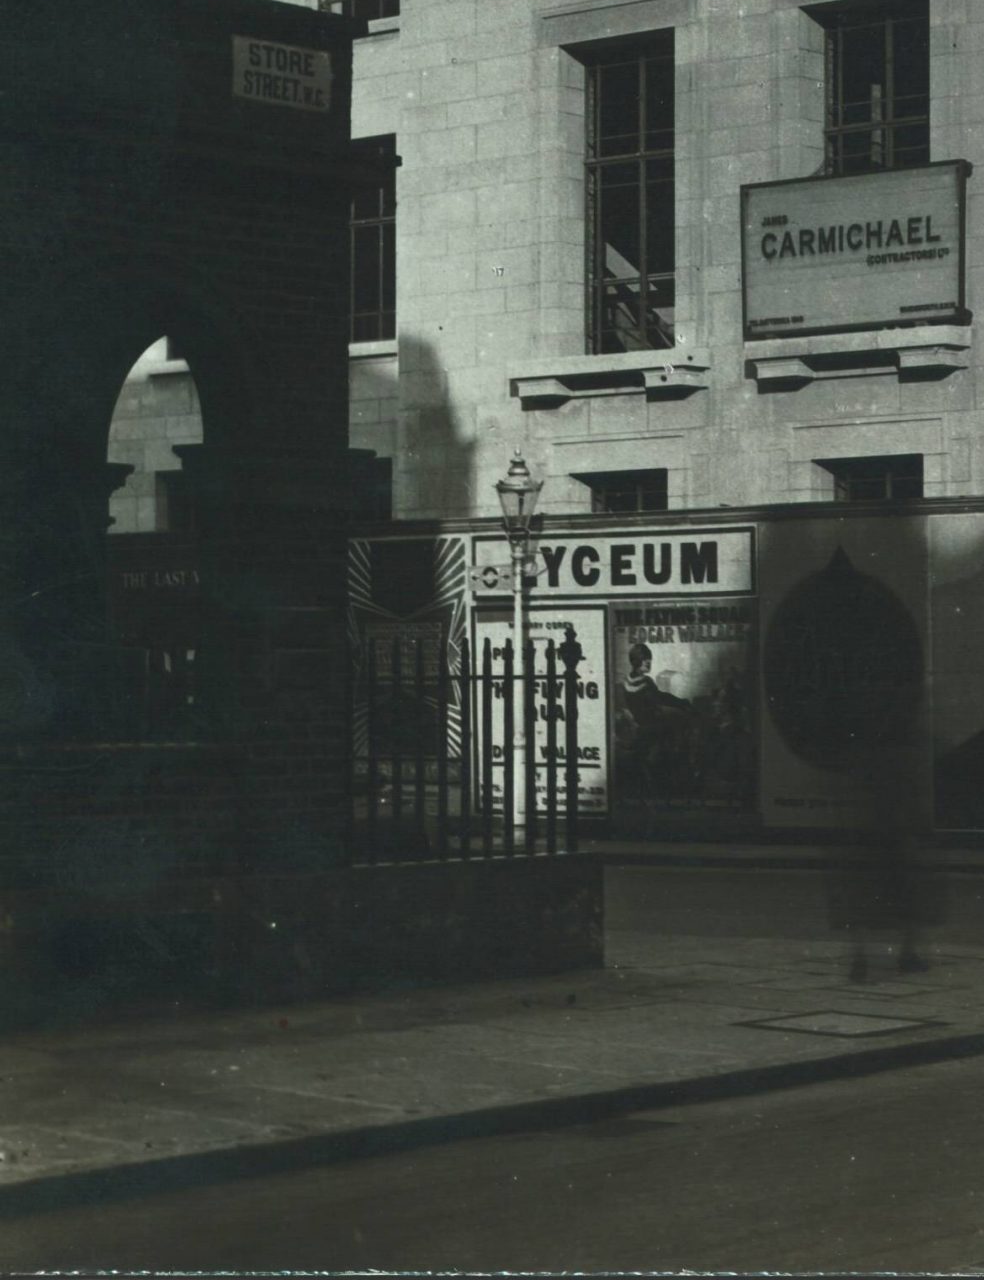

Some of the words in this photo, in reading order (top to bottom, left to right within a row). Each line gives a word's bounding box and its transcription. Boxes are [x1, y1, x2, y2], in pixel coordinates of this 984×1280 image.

[249, 42, 315, 78] STORE
[761, 215, 941, 260] CARMICHAEL
[121, 571, 148, 589] THE
[153, 570, 186, 587] LAST
